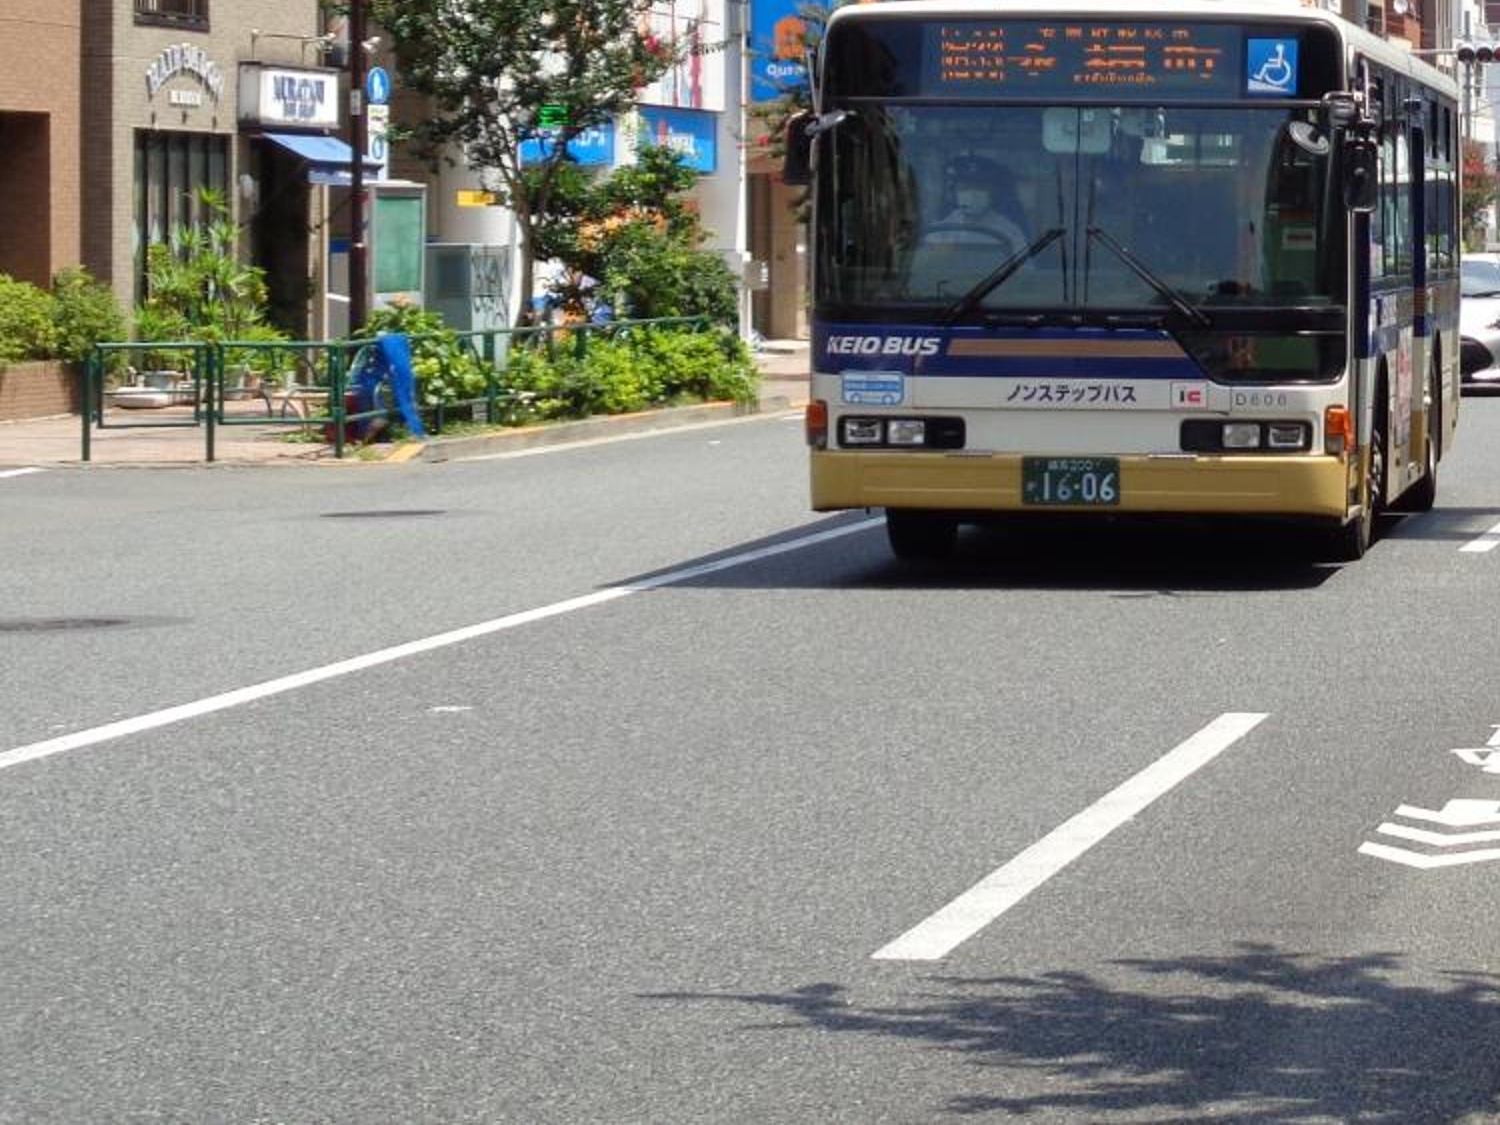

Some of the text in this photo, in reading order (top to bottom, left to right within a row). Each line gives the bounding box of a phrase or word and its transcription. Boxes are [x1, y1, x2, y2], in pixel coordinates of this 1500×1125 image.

[827, 335, 941, 356] KEIO BUS
[1007, 383, 1137, 403] ノンステップバス
